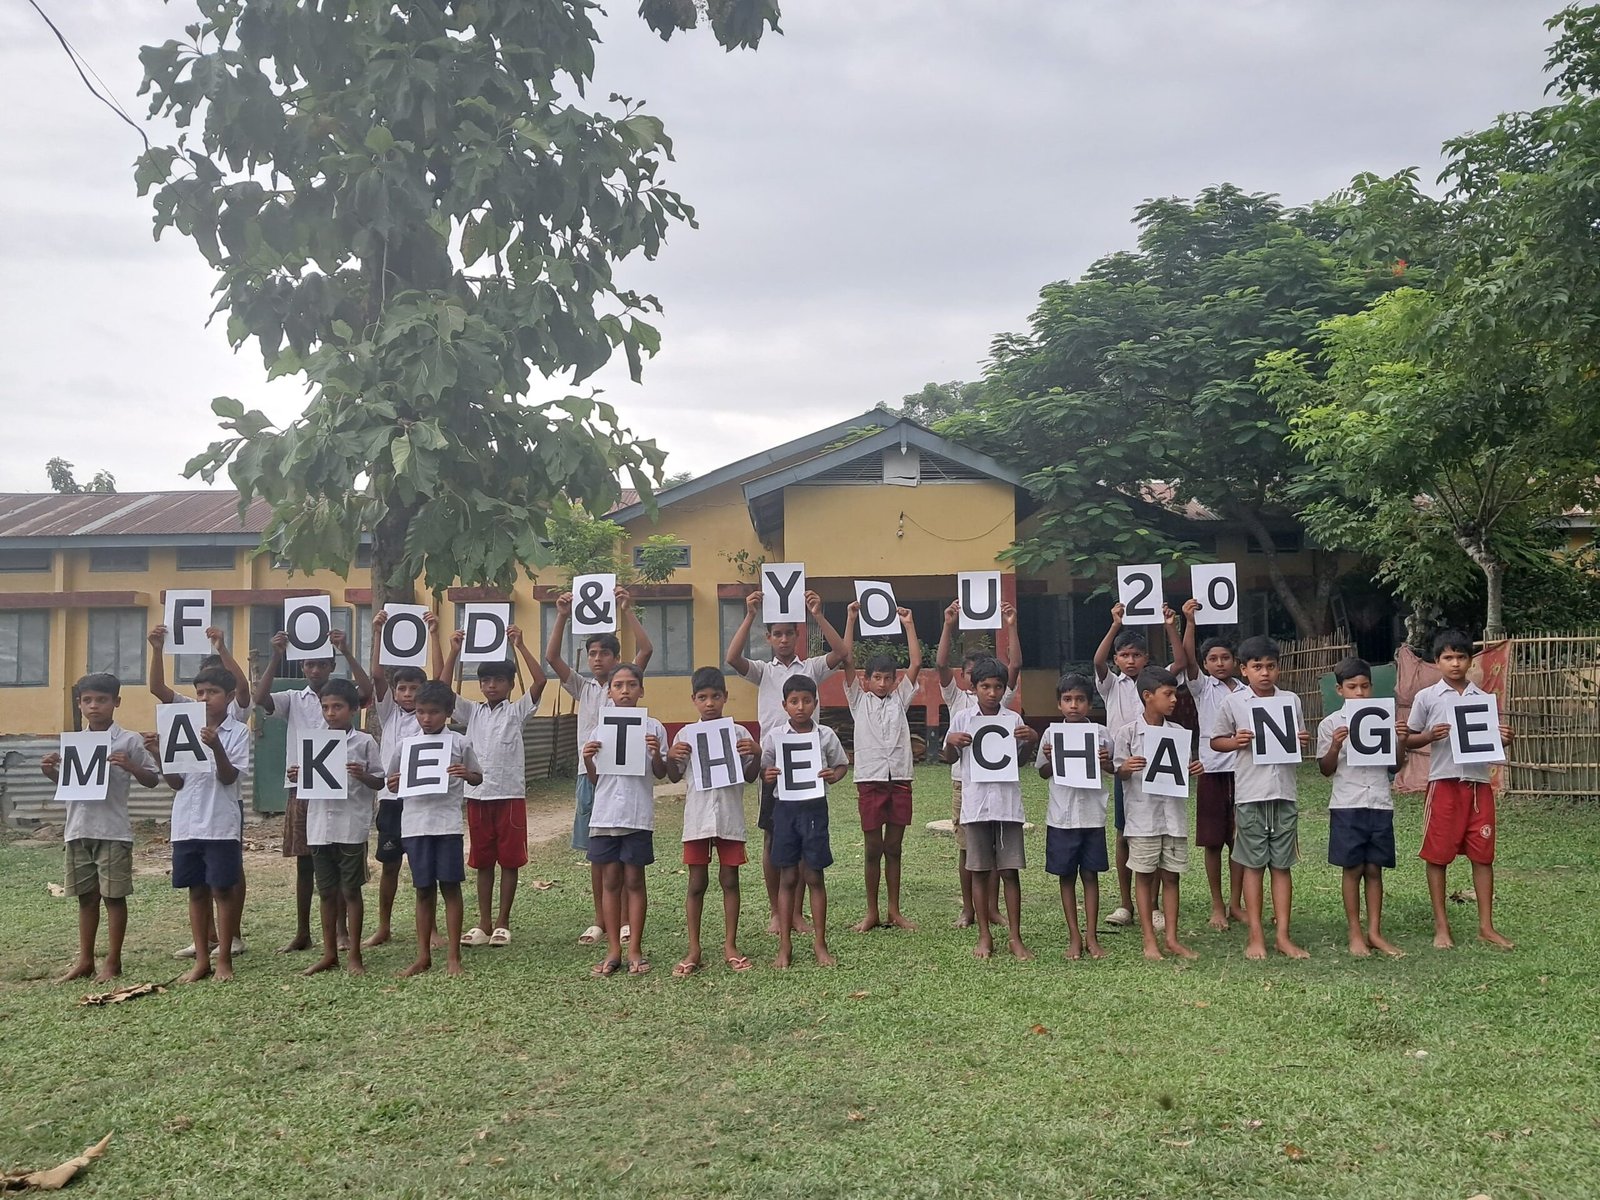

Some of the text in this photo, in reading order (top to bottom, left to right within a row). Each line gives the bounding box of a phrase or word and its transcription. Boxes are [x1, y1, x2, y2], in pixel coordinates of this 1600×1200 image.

[574, 581, 613, 626] &
[764, 570, 803, 614] Y
[962, 578, 998, 621] U
[1123, 573, 1155, 617] 2
[174, 599, 204, 645] F
[465, 613, 506, 654] D
[164, 713, 208, 763] A
[603, 716, 642, 766] T
[972, 724, 1012, 771] C
[1251, 705, 1298, 755] N
[1350, 706, 1391, 755] G
[1454, 703, 1496, 754] E
[62, 745, 108, 787] M
[303, 739, 343, 790] K
[406, 742, 444, 788] E
[697, 728, 738, 788] H
[782, 742, 817, 791] E
[1054, 732, 1097, 780] H
[1145, 737, 1186, 787] A
